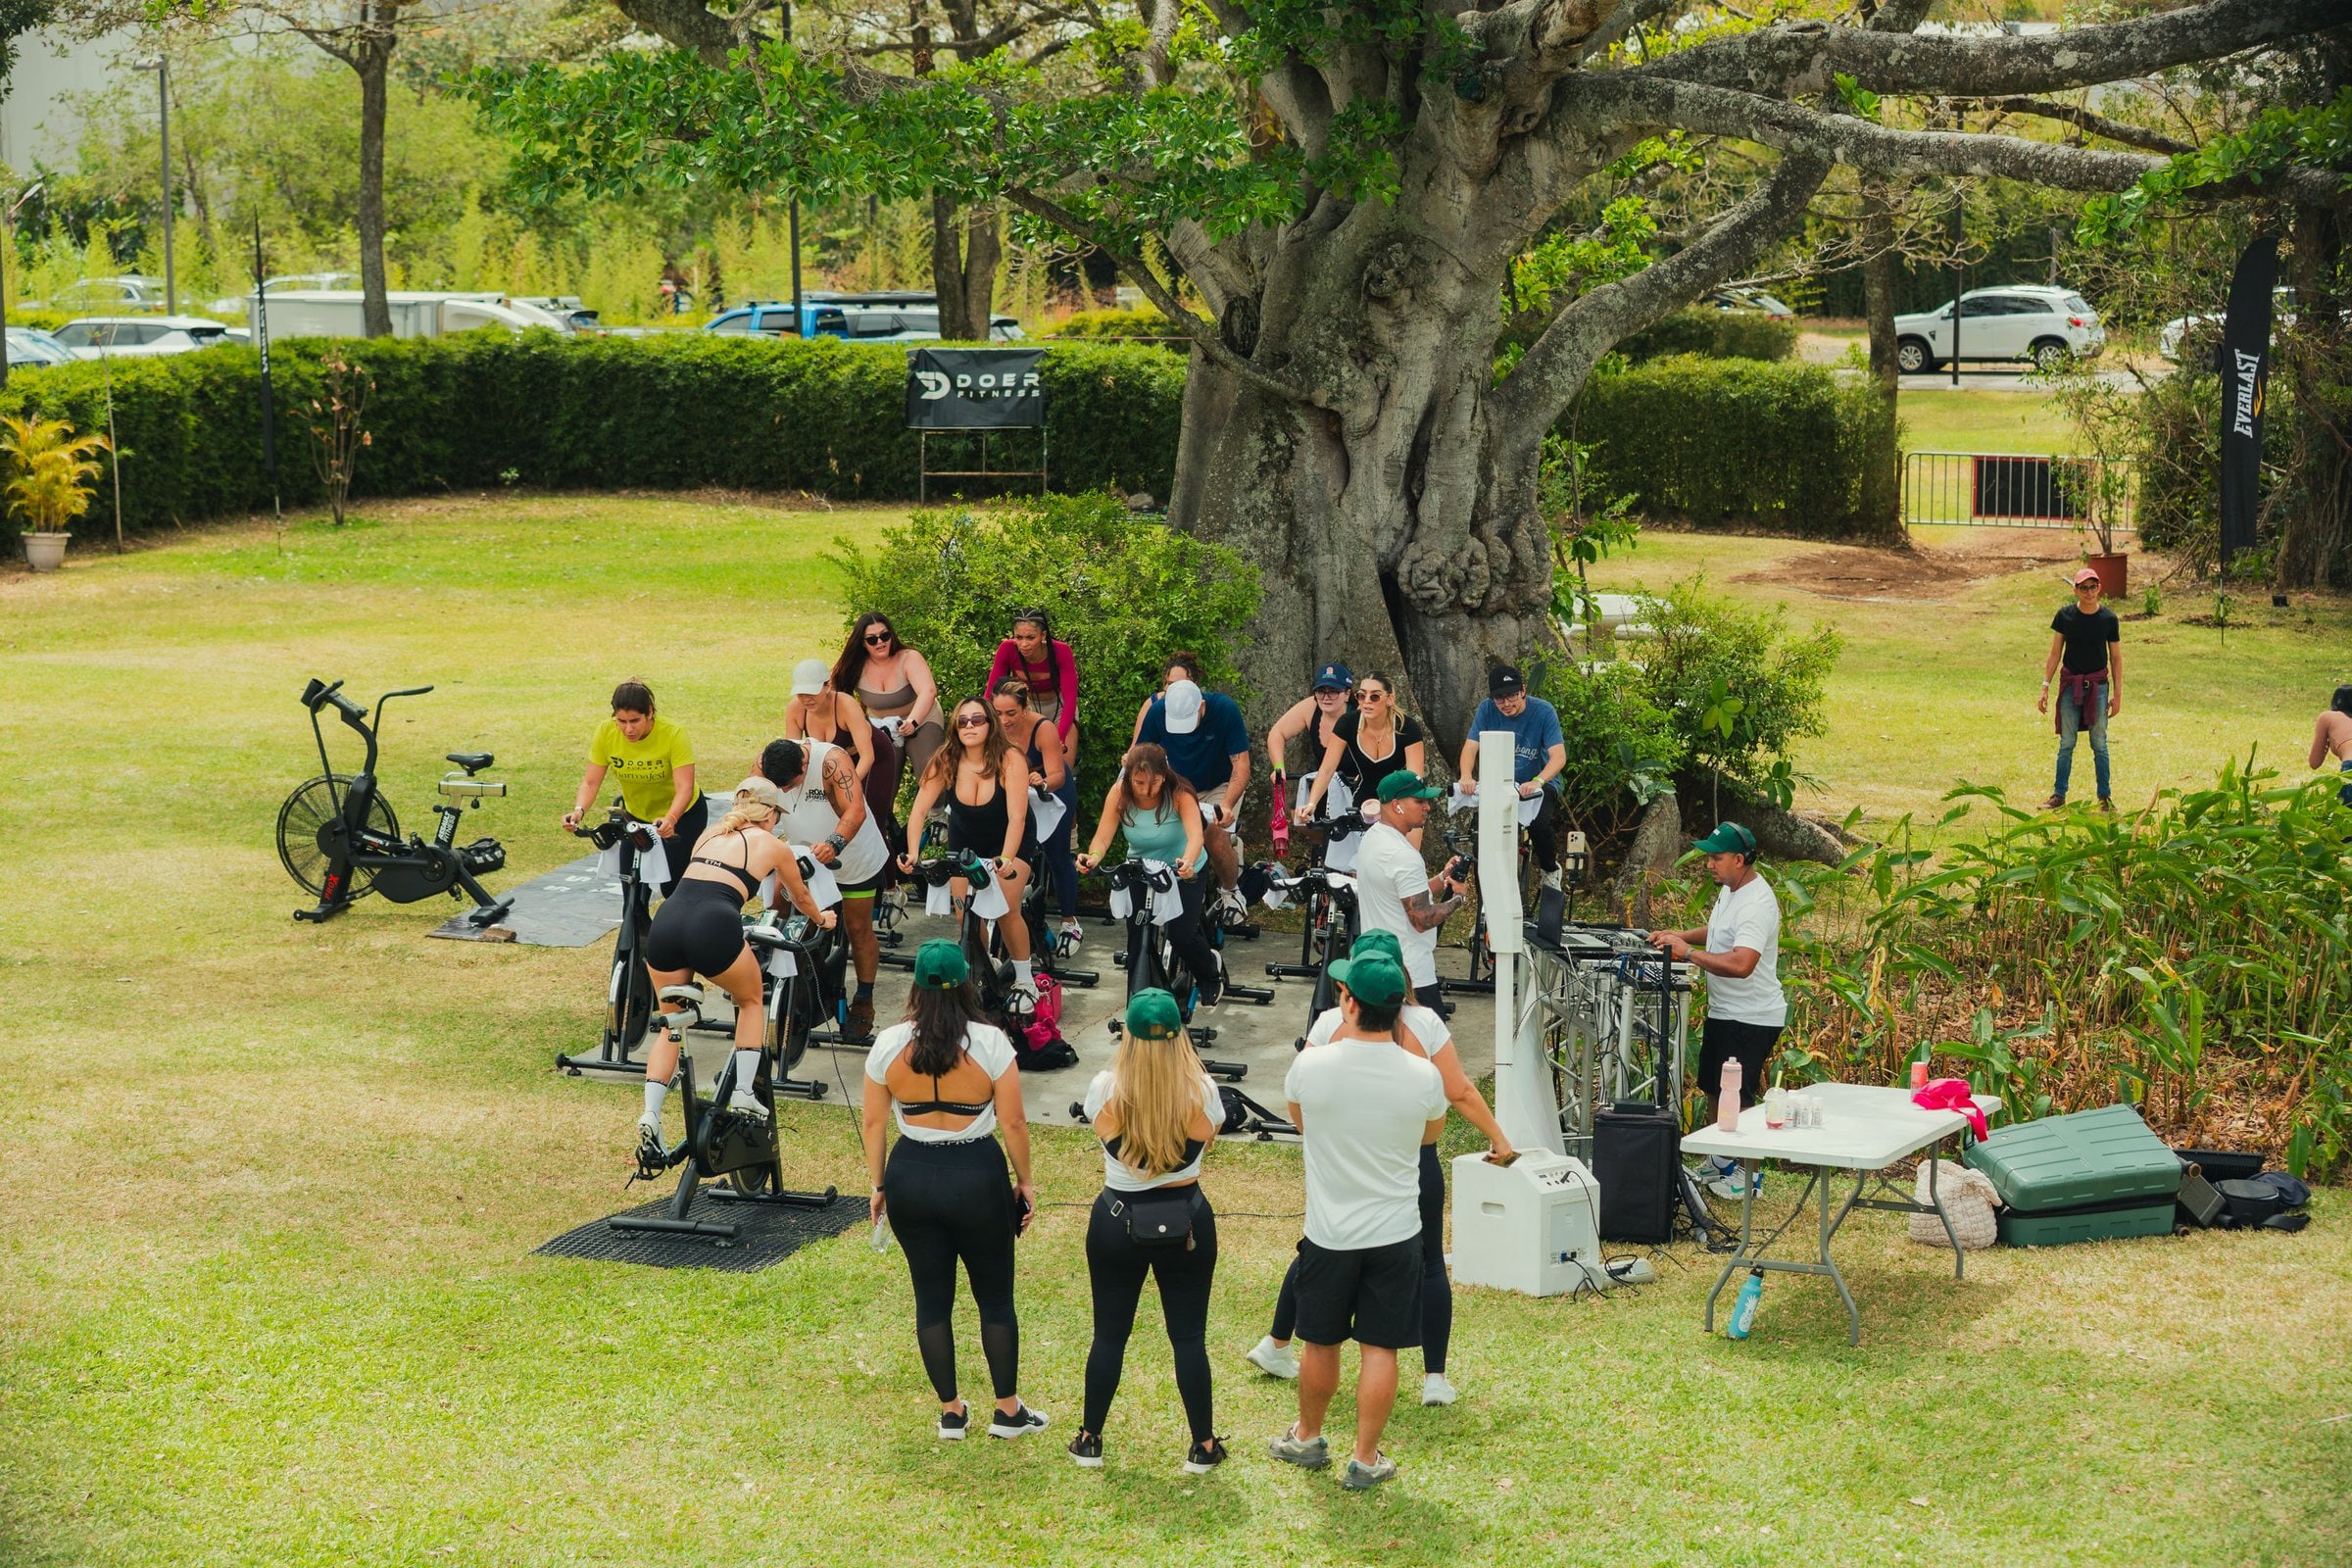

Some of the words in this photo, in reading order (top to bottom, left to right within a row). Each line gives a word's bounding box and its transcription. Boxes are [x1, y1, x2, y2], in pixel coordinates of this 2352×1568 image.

[956, 372, 1040, 388] DOER
[956, 389, 1040, 399] FITNESS
[2234, 348, 2260, 438] EVERLAST
[438, 810, 451, 840] ASSAULT
[443, 814, 456, 842] FITNESS
